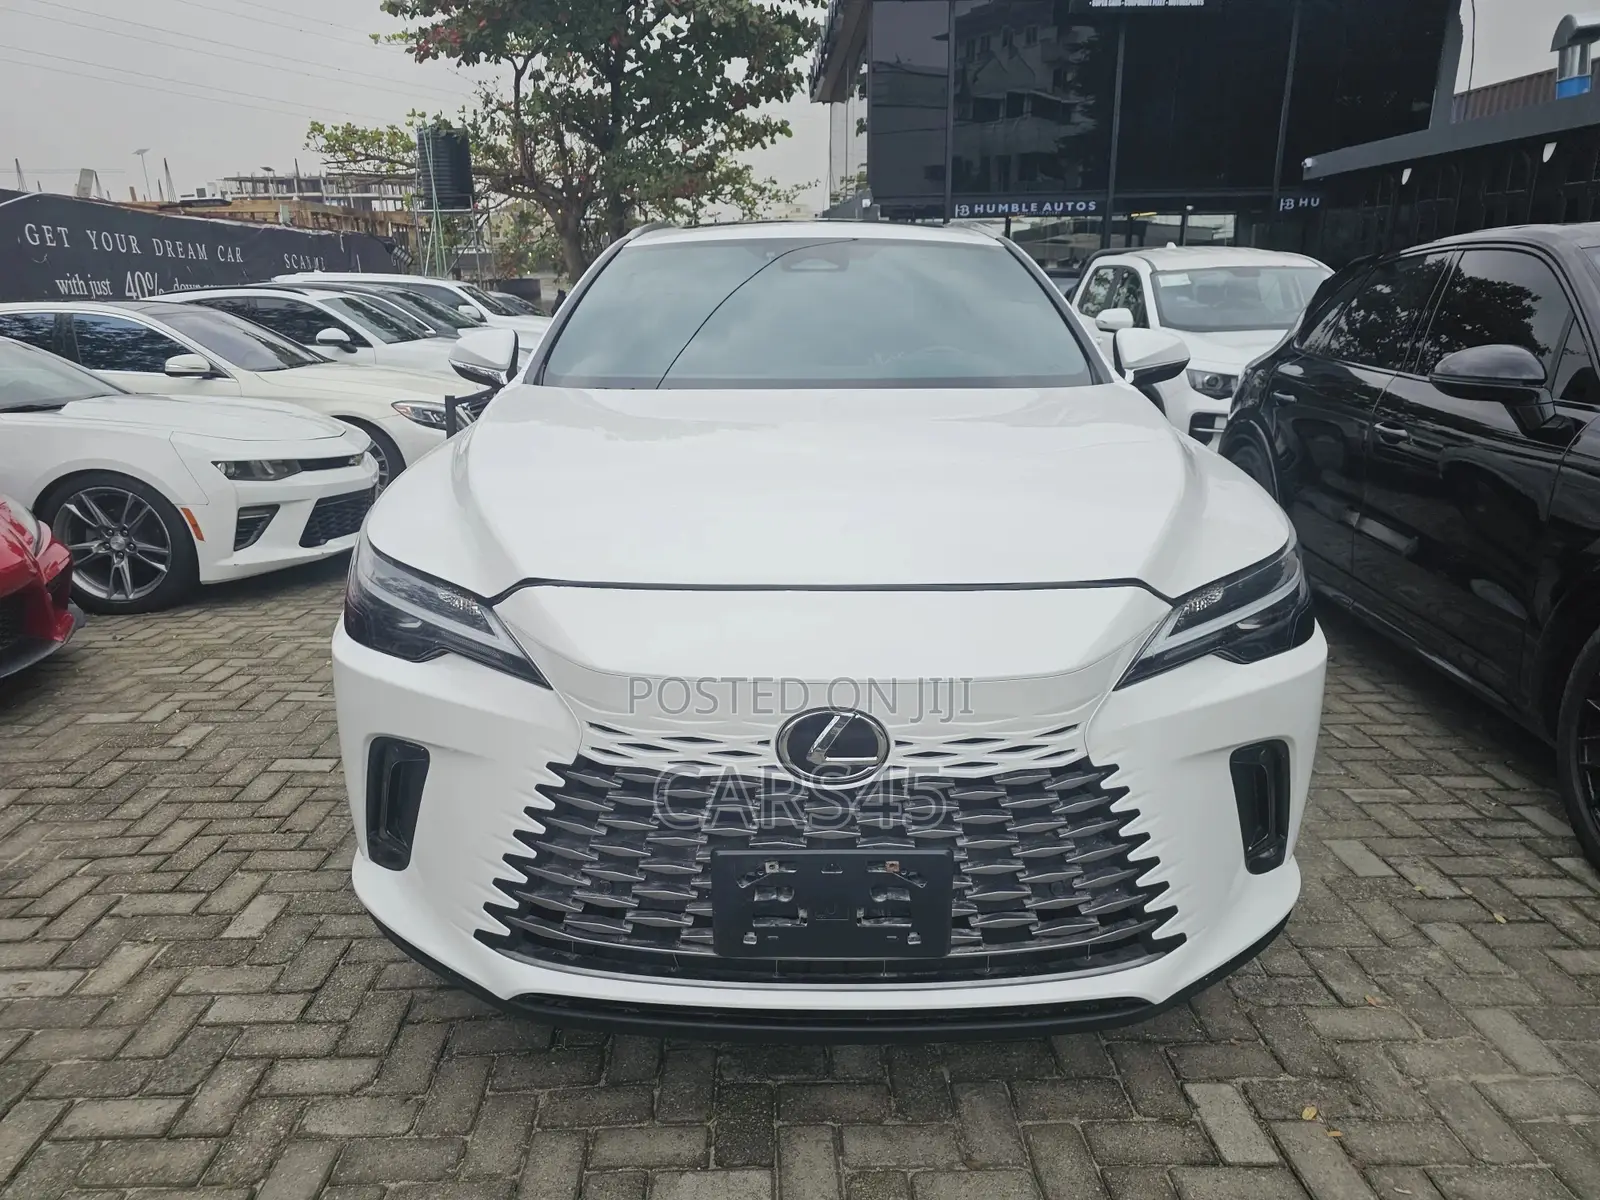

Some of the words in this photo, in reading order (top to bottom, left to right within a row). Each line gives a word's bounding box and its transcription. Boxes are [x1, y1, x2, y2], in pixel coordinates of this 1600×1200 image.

[974, 202, 1038, 214] HUMBLE
[1043, 201, 1096, 212] AUTOS
[24, 223, 71, 248] GET
[86, 229, 142, 254] YOUR
[152, 238, 208, 261] DREAM
[217, 245, 243, 263] CAR
[55, 272, 88, 295] with
[88, 273, 113, 299] just
[125, 271, 165, 299] 40%
